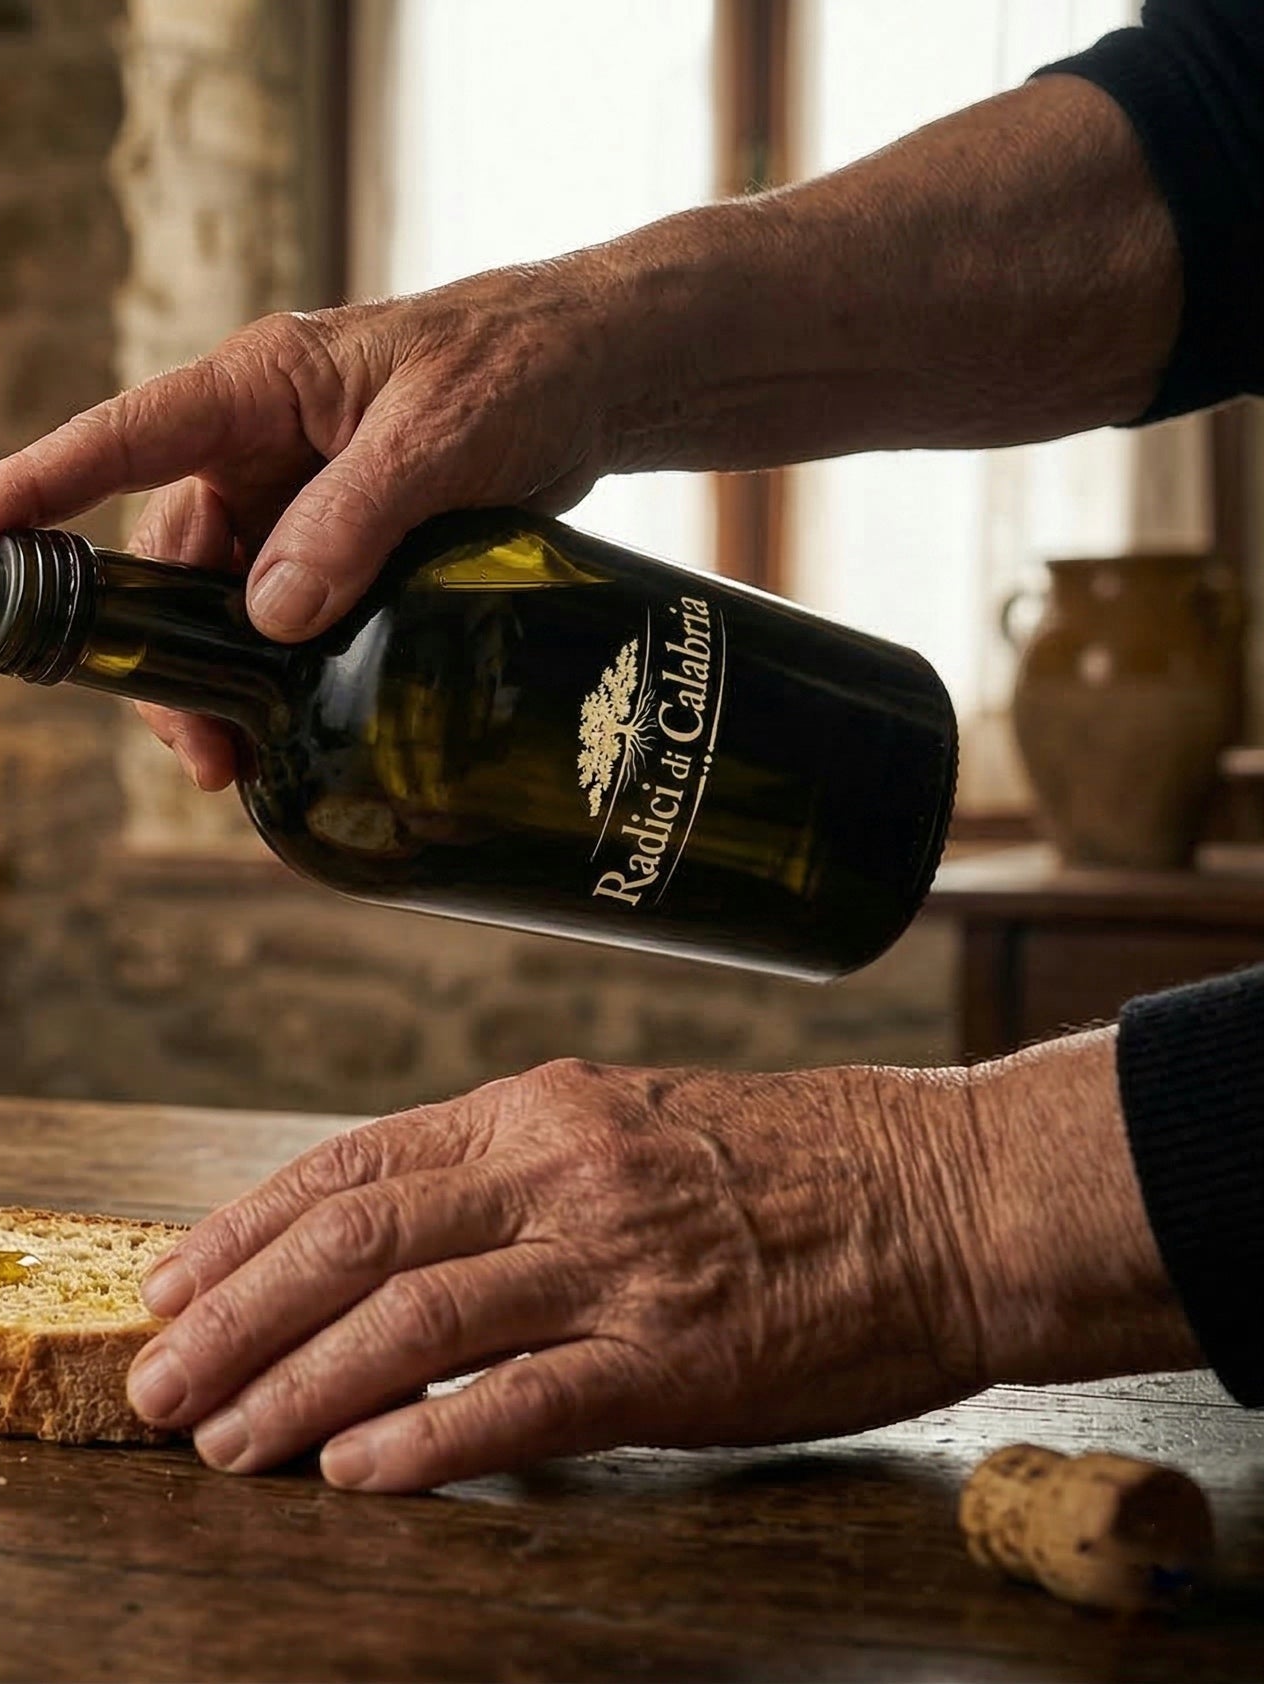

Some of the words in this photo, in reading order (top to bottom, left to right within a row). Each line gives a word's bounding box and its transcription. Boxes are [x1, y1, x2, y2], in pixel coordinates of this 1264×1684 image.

[658, 596, 712, 743] Calabria
[660, 750, 692, 780] di
[591, 782, 684, 907] Radici
